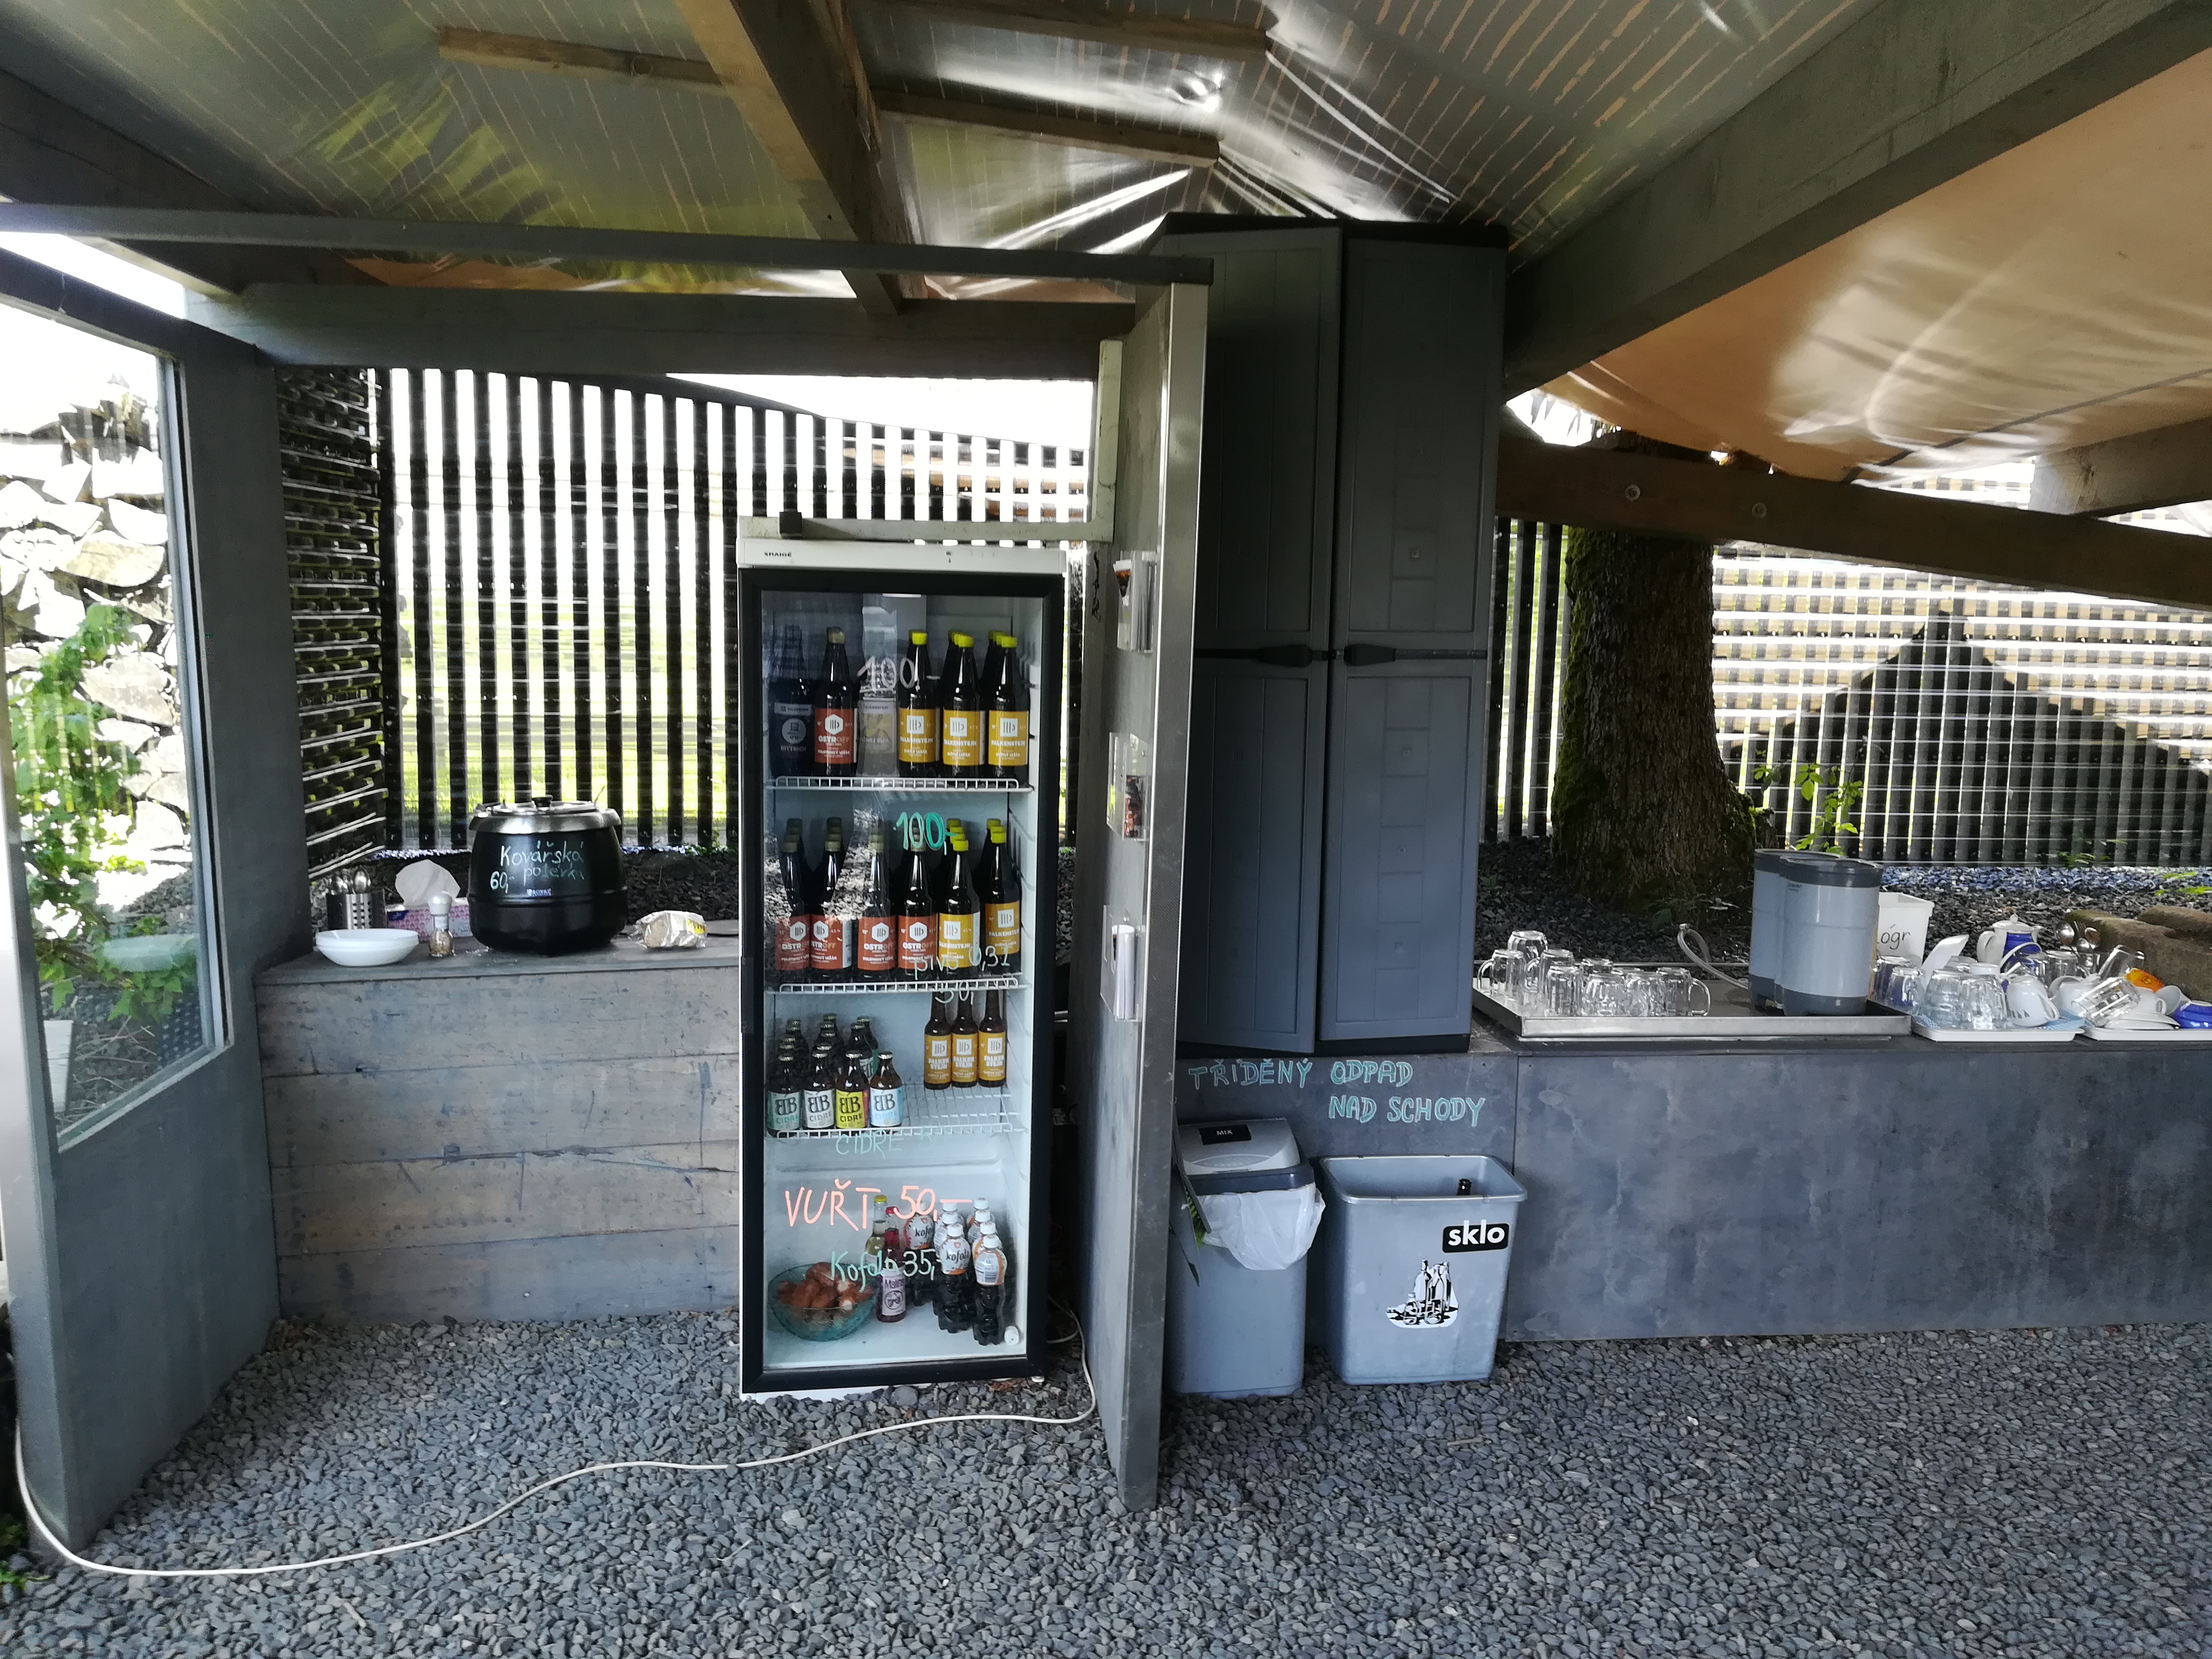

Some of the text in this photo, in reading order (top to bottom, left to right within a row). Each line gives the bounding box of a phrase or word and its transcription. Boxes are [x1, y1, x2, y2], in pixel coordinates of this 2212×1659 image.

[1876, 923, 1911, 950] ógr
[1331, 1060, 1413, 1087] ODPAD
[840, 1113, 863, 1123] CIDRE
[1329, 1094, 1486, 1127] NAD SCHODY
[836, 1128, 904, 1160] CIDRE
[785, 1178, 881, 1231] VUŘT
[1448, 1219, 1505, 1246] sklo
[945, 1250, 970, 1263] kofola
[830, 1250, 899, 1293] Kofola
